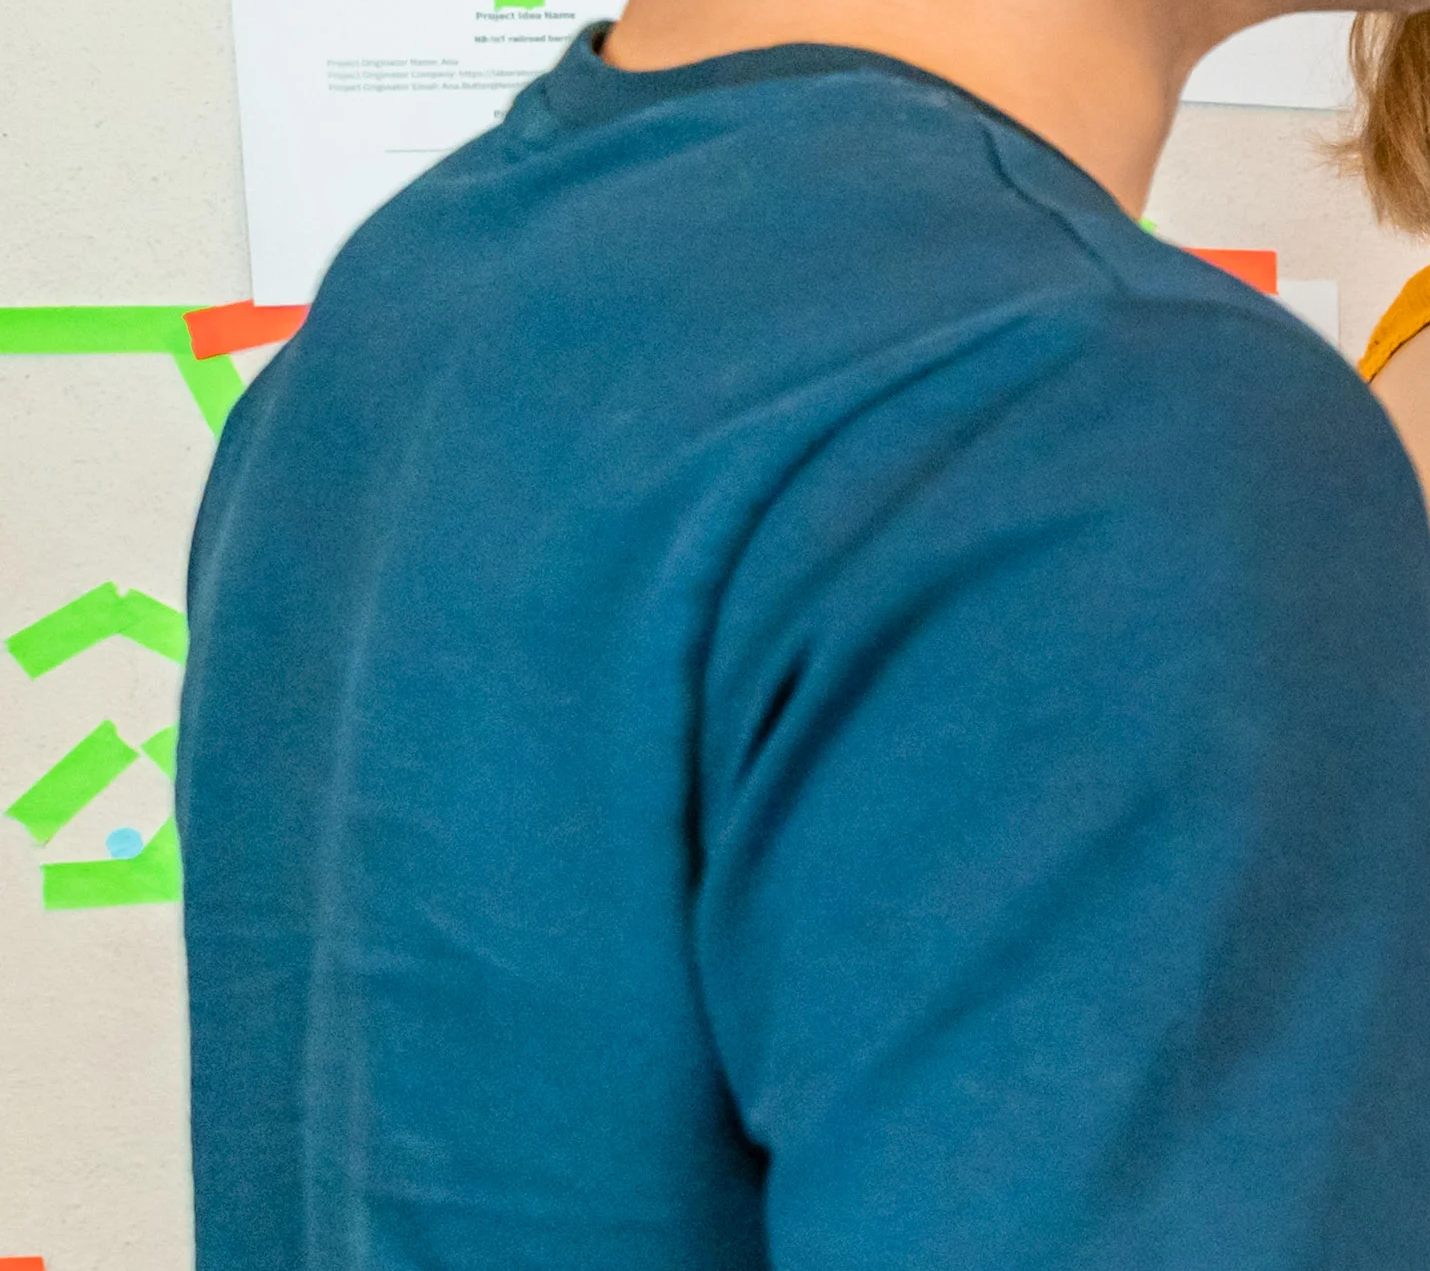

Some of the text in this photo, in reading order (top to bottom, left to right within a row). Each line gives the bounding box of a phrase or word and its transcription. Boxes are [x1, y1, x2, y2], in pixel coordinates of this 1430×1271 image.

[475, 11, 576, 22] Project Idea Name
